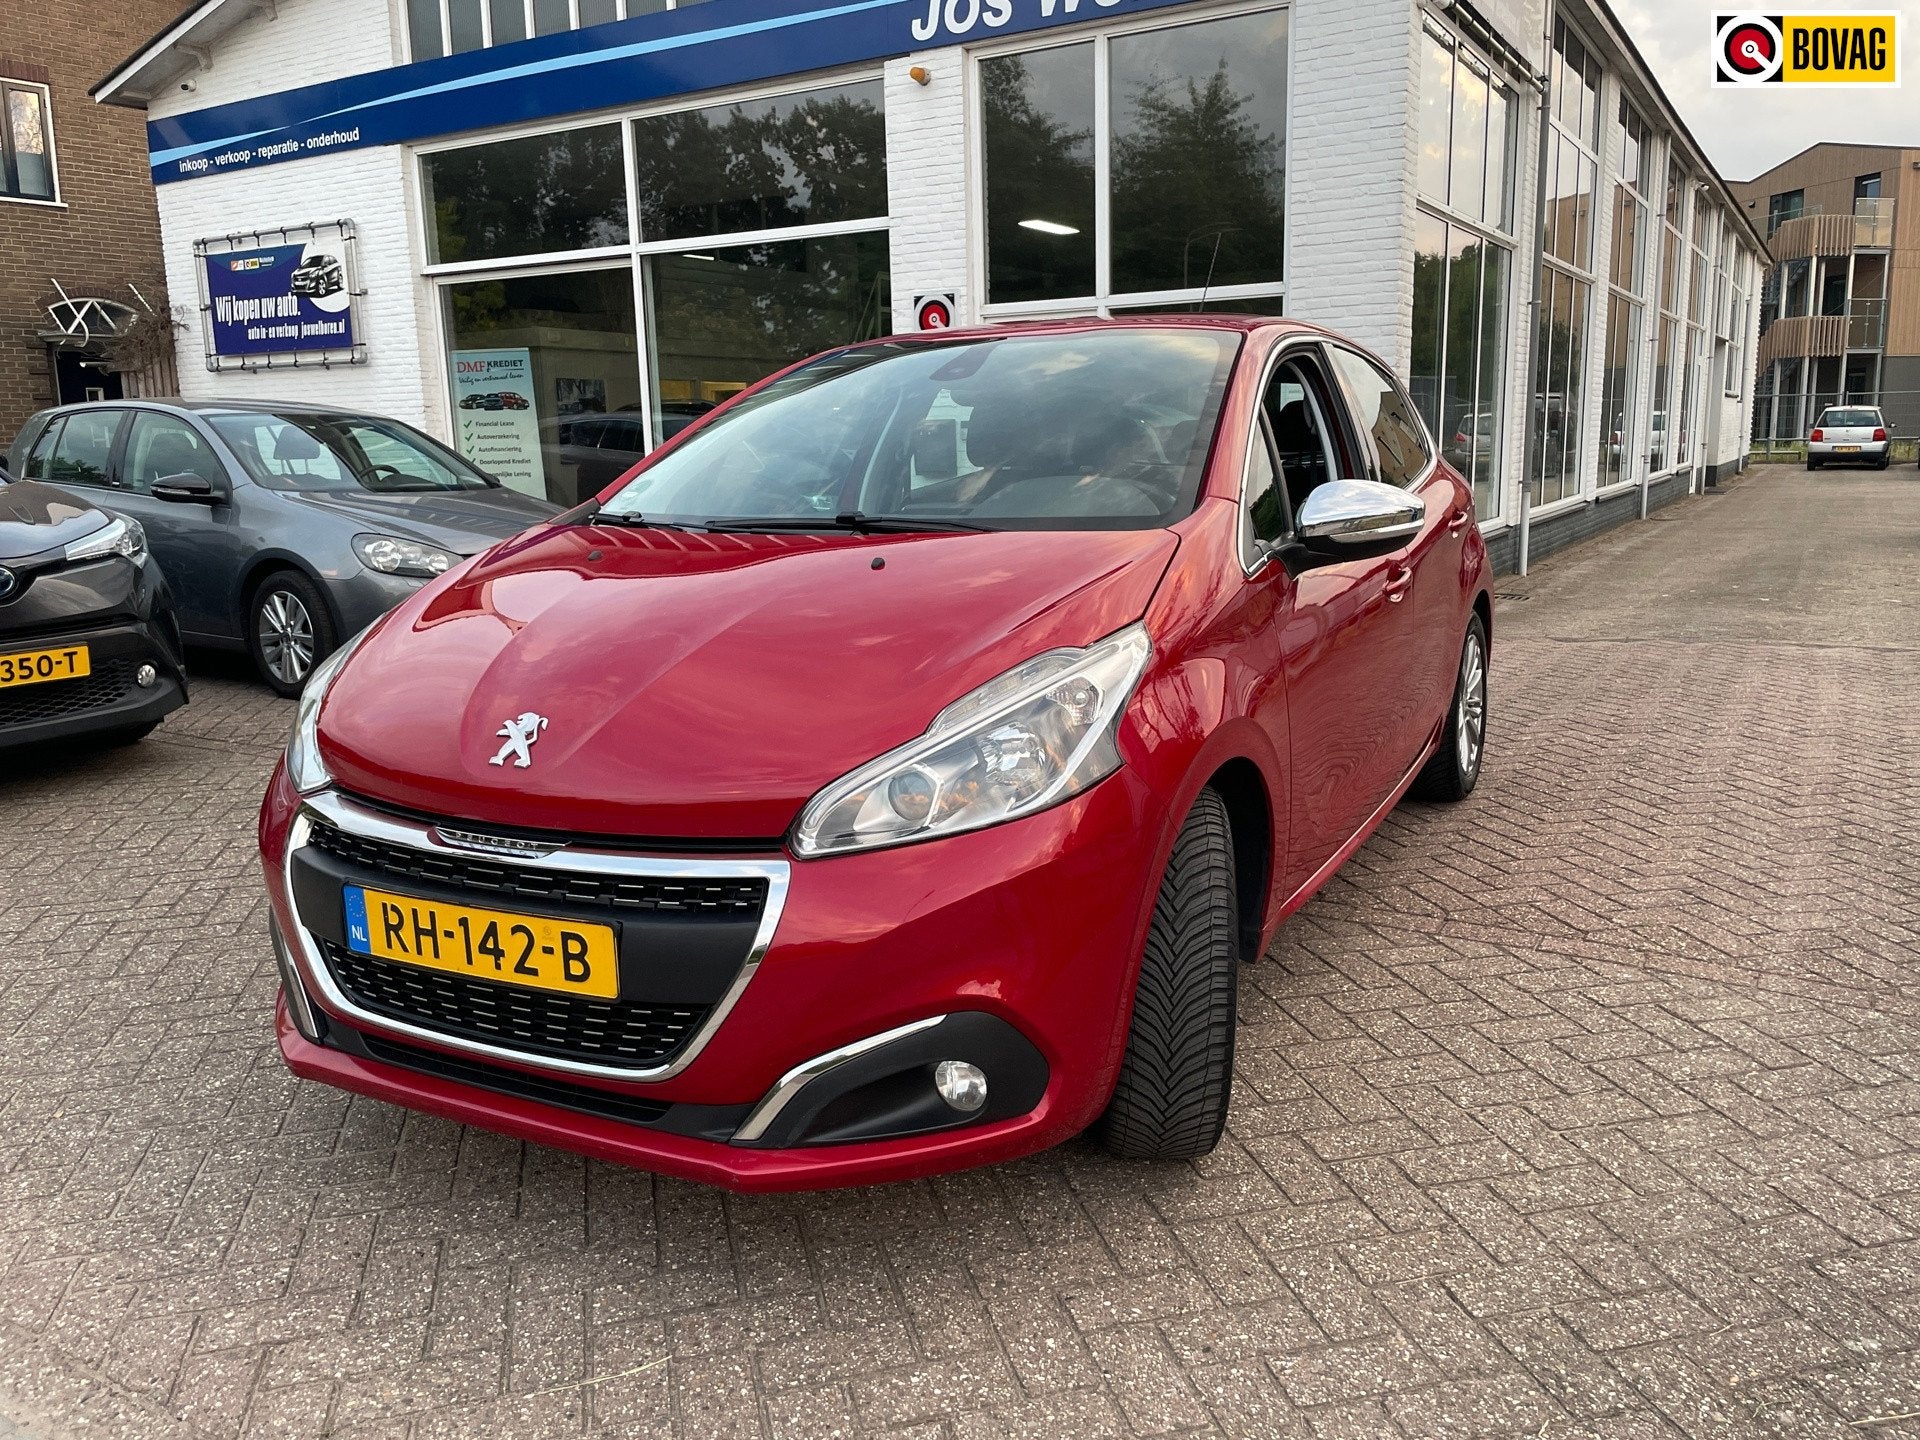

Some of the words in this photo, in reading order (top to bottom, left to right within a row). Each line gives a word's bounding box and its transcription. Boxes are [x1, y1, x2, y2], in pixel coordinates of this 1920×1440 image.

[179, 159, 209, 173] inkoop
[215, 150, 251, 166] verkoop
[258, 140, 299, 160] reparatie
[306, 126, 360, 150] onderhoud
[215, 295, 232, 327] Wij
[232, 295, 261, 326] kopen
[261, 296, 276, 319] uw
[277, 291, 301, 318] auto.
[276, 322, 299, 340] verkoop
[457, 360, 486, 374] DMF
[486, 359, 524, 369] KREDIET
[479, 458, 511, 466] Doorlopend
[0, 650, 79, 683] 350-T
[456, 830, 539, 850] PEUGEOT
[351, 923, 368, 942] NL
[381, 901, 592, 983] RH-142-B
